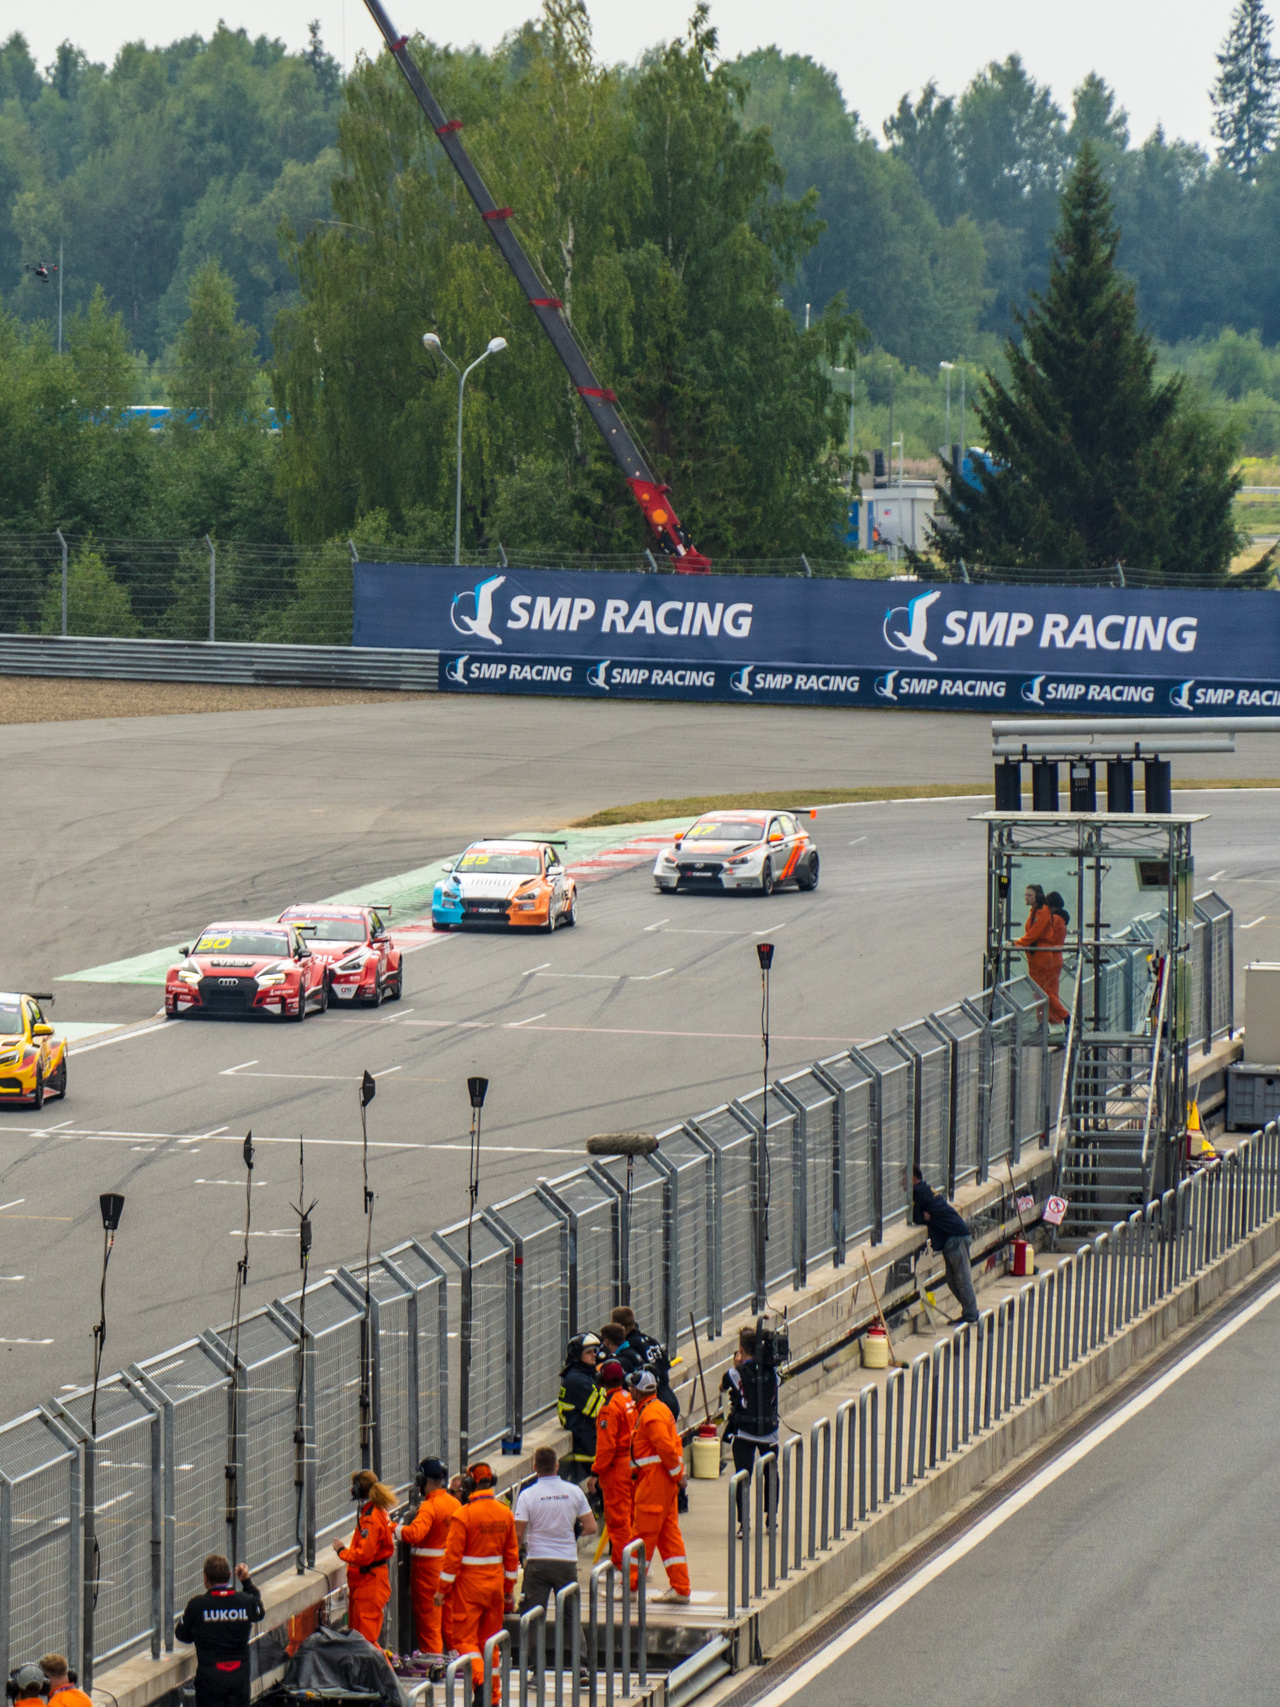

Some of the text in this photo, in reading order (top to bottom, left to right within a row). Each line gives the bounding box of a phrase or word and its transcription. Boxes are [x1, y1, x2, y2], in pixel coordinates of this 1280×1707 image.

[507, 595, 753, 638] SMP RACING
[941, 610, 1198, 653] SMP RACING
[469, 662, 573, 683] SMP RACING
[610, 667, 716, 687] SMP RACING
[754, 672, 860, 692] SMP RACING
[898, 677, 1007, 698] SMP RACING
[1045, 682, 1155, 703] SMP RACING
[1194, 687, 1280, 706] SMP RACI
[460, 855, 491, 866] 25
[198, 938, 232, 950] 50
[203, 1608, 249, 1621] LUKOIL
